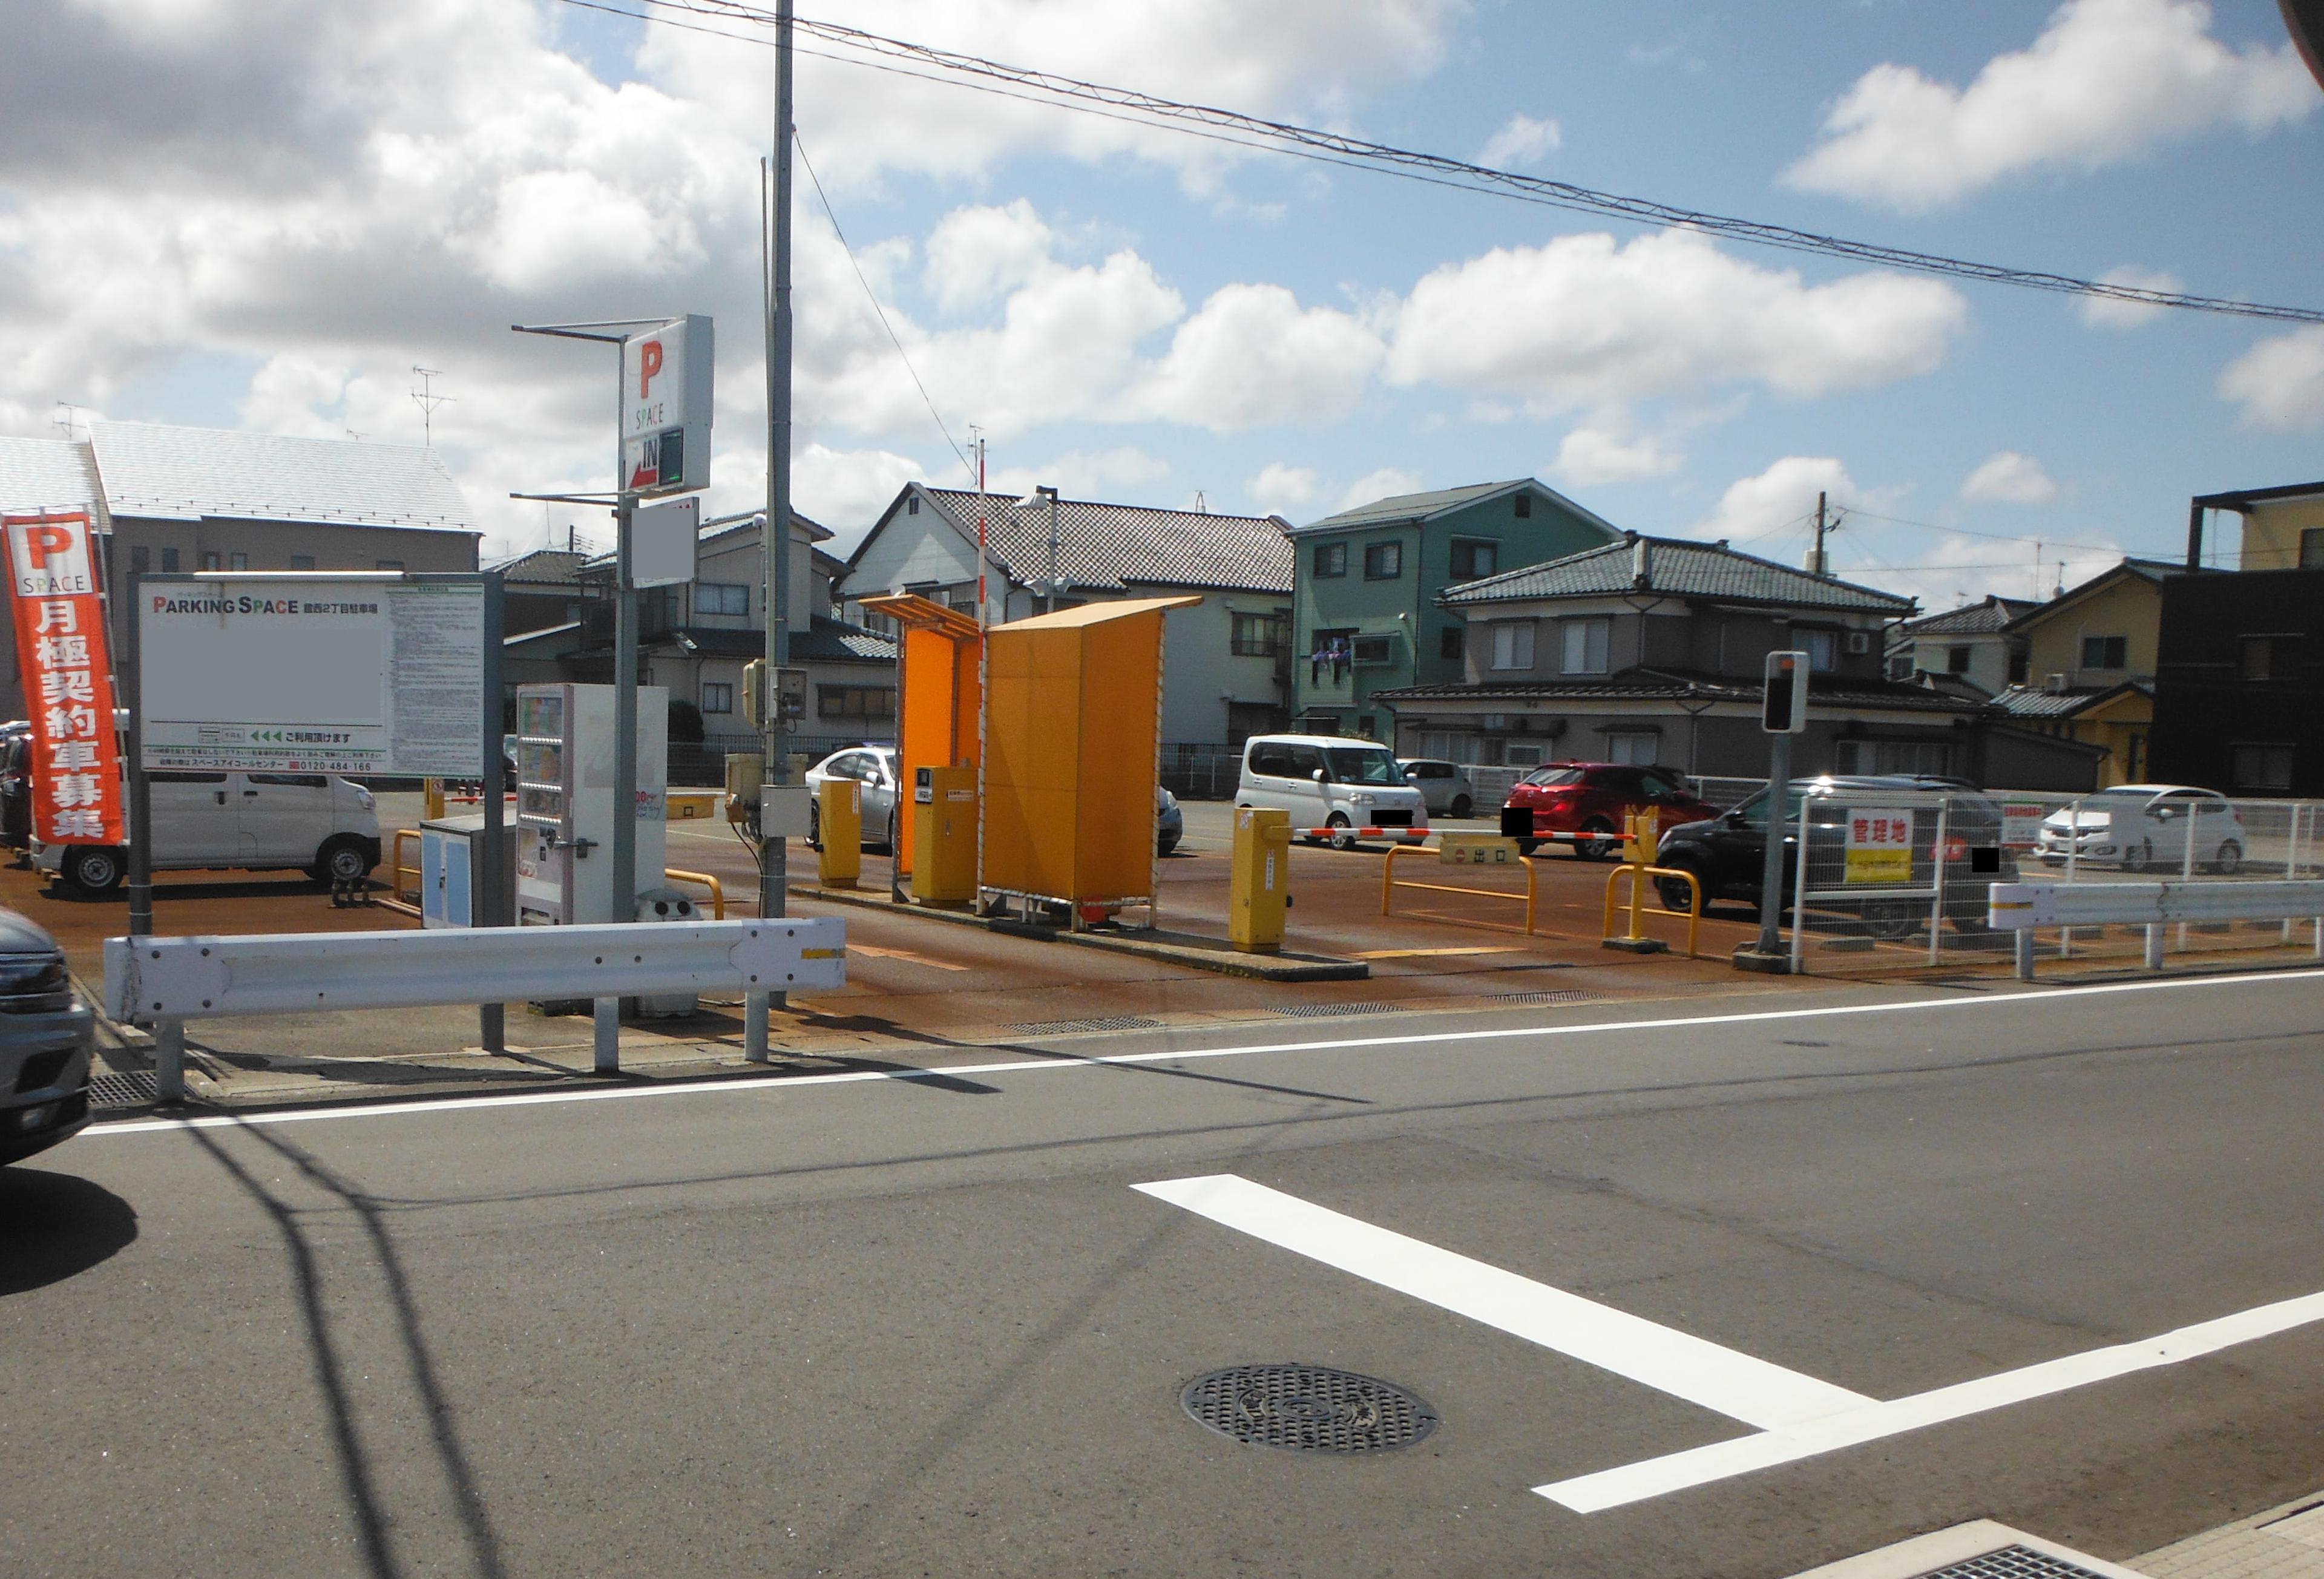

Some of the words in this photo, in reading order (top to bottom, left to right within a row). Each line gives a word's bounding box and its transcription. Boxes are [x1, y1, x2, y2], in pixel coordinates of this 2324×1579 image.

[641, 341, 663, 399] P
[636, 402, 663, 430] SPACE
[643, 439, 658, 469] IN
[26, 526, 73, 570] P
[24, 575, 85, 593] SPACE
[153, 596, 235, 614] PARKING
[238, 595, 299, 614] SPACE
[34, 600, 105, 838] 月極契約車募集
[1853, 818, 1906, 843] 管理地
[1474, 849, 1505, 862] 出口
